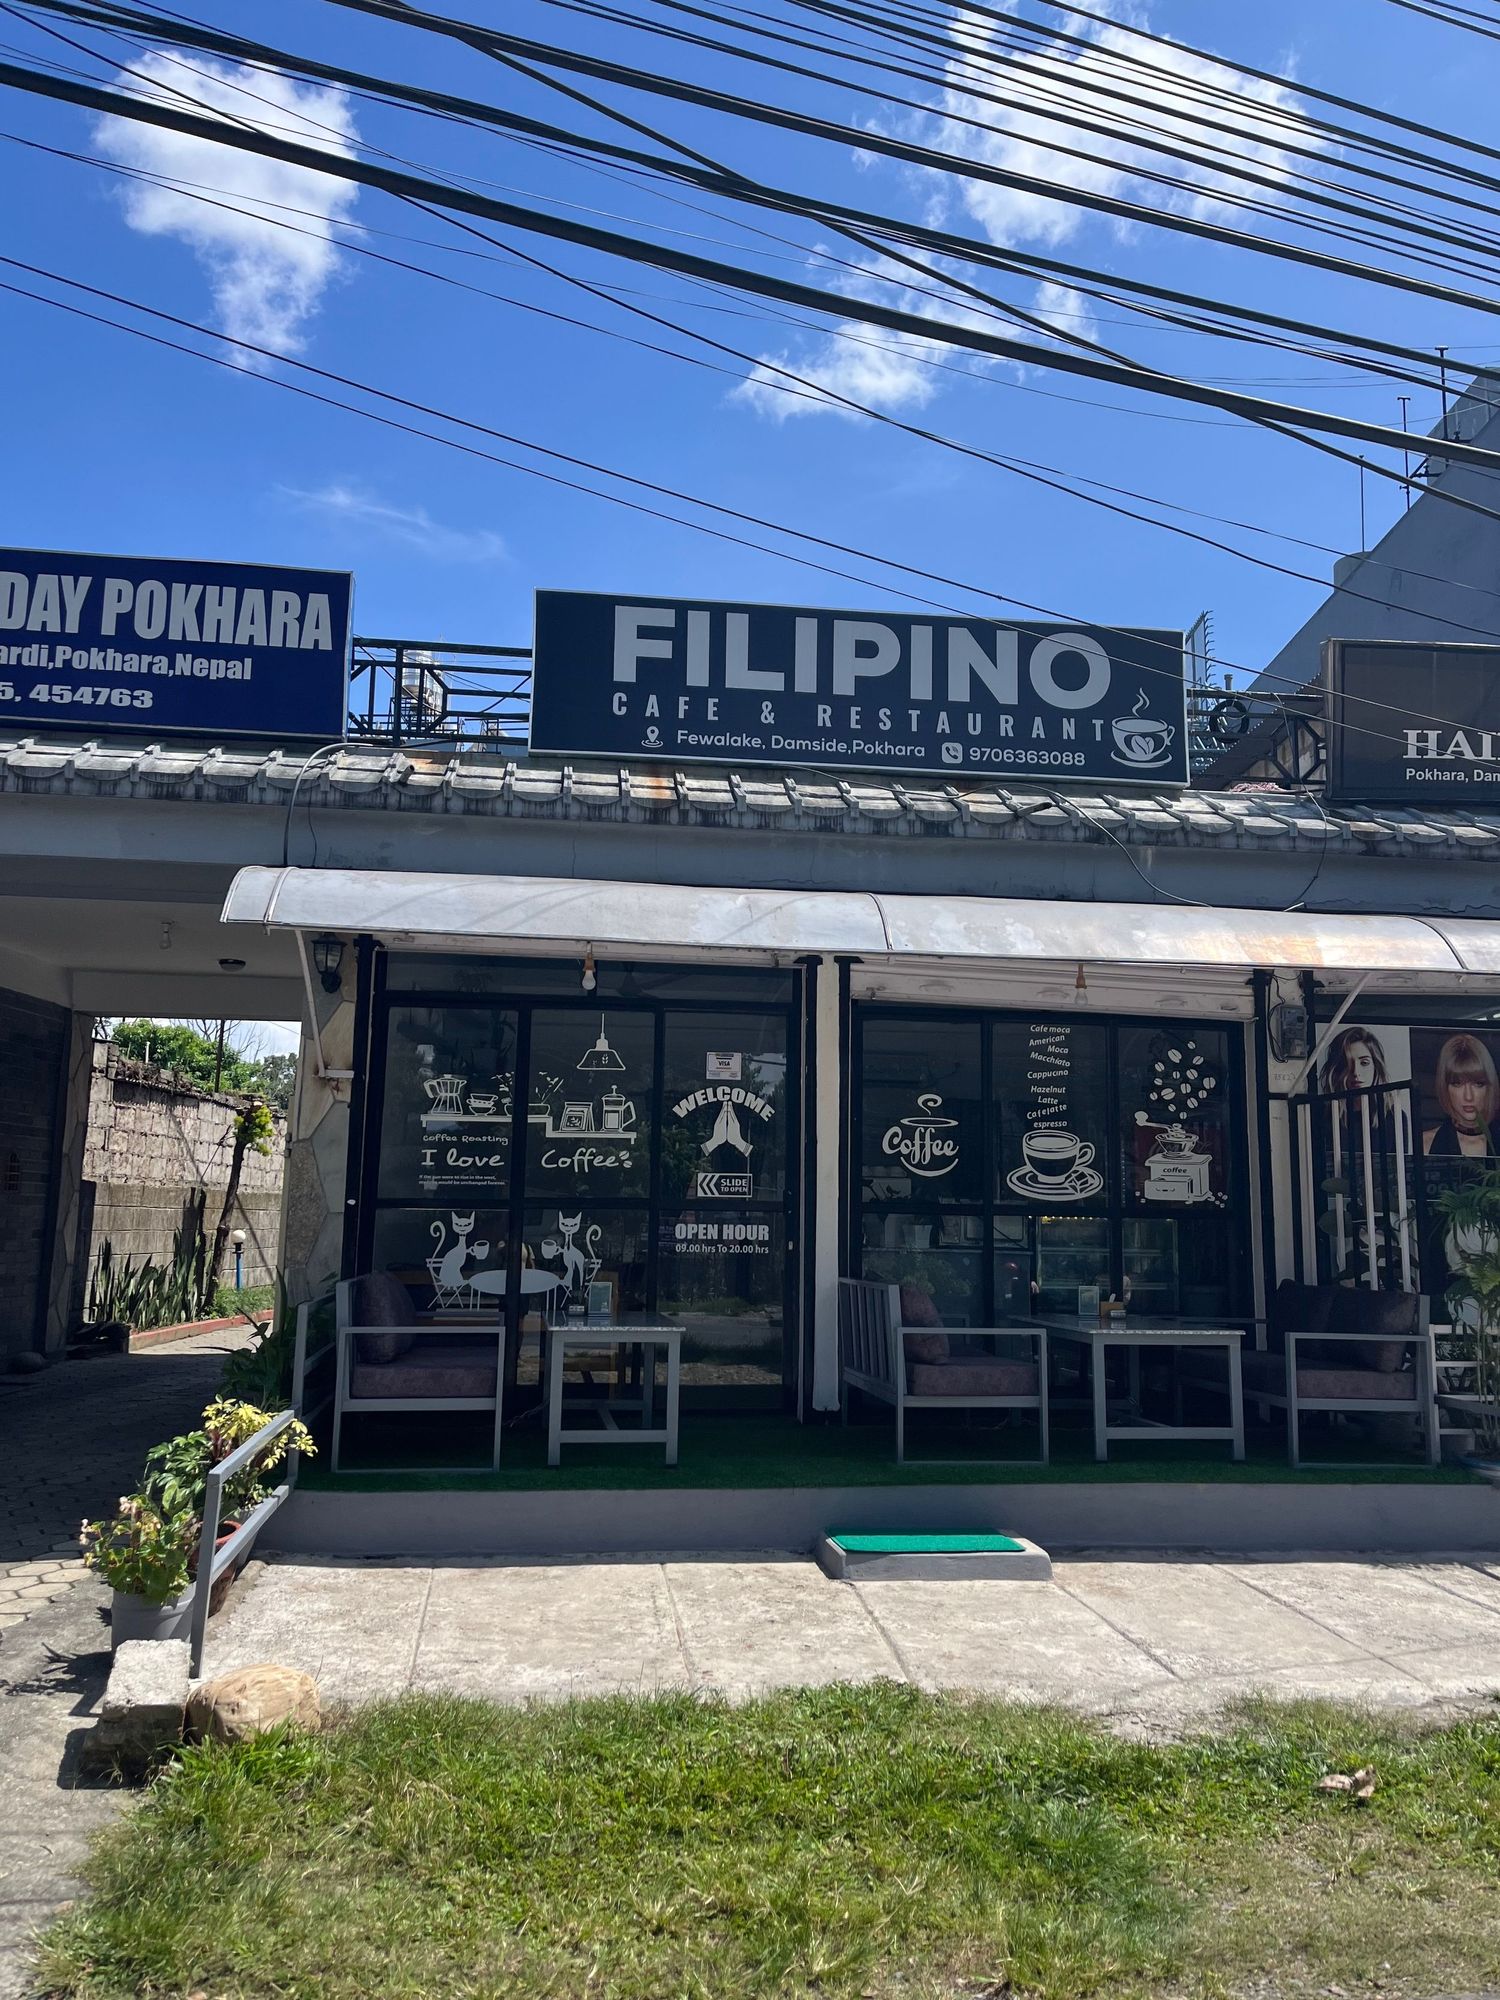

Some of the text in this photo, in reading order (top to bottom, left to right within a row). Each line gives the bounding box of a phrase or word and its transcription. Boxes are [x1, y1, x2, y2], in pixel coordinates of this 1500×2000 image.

[100, 577, 333, 651] POKHARA
[612, 604, 1112, 710] FILIPINO
[29, 684, 154, 709] 454763
[612, 691, 1104, 741] CAFE & RESTAURANT
[677, 729, 766, 750] Fewalake,
[1402, 730, 1500, 760] HAI
[969, 747, 1086, 767] 9706363088
[1405, 768, 1469, 783] Pokhara,
[1028, 1034, 1065, 1047] American
[1047, 1045, 1069, 1054] Moca
[1030, 1051, 1071, 1067] Macchiato
[1027, 1069, 1069, 1080] Cappucino
[1030, 1085, 1066, 1094] Hazelnut
[671, 1085, 776, 1123] WELCOME
[1037, 1095, 1059, 1105] Latte
[1033, 1120, 1068, 1130] espresso
[882, 1126, 960, 1165] Coffee
[420, 1147, 620, 1173] I love Coffee
[1162, 1166, 1188, 1174] coffee
[720, 1178, 747, 1187] SLIDE
[675, 1223, 718, 1240] OPEN
[722, 1224, 769, 1241] HOUR
[675, 1244, 769, 1254] 09.00 hrs To 20.00 hrs
